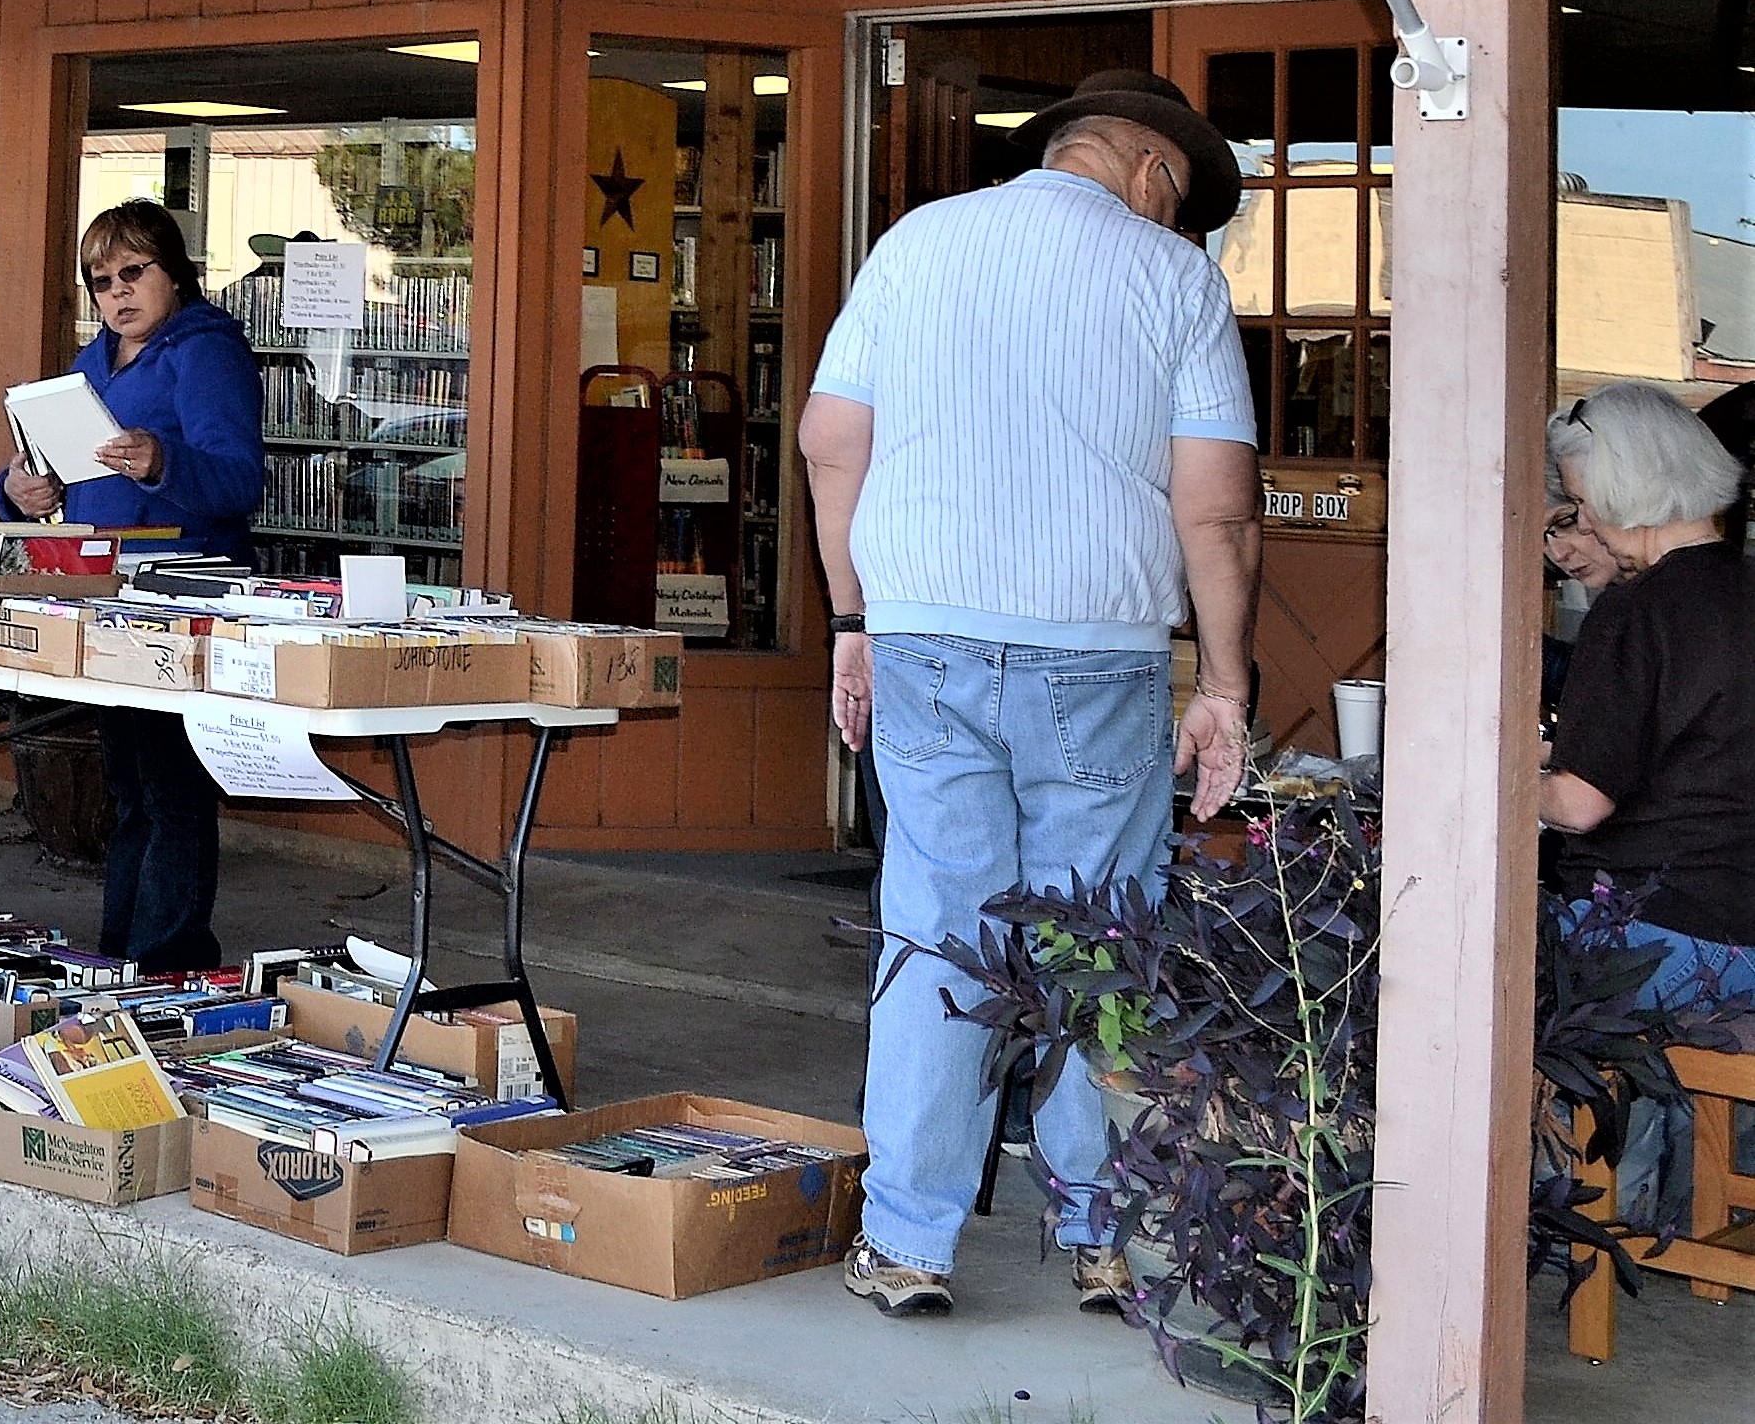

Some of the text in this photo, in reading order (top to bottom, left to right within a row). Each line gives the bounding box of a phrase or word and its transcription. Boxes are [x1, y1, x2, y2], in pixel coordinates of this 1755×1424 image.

[1269, 493, 1346, 518] ROP BOX
[47, 1133, 105, 1156] McNaughton
[49, 1147, 105, 1172] Book Service
[265, 1150, 335, 1181] CLOROX
[710, 1183, 767, 1206] FEEDING
